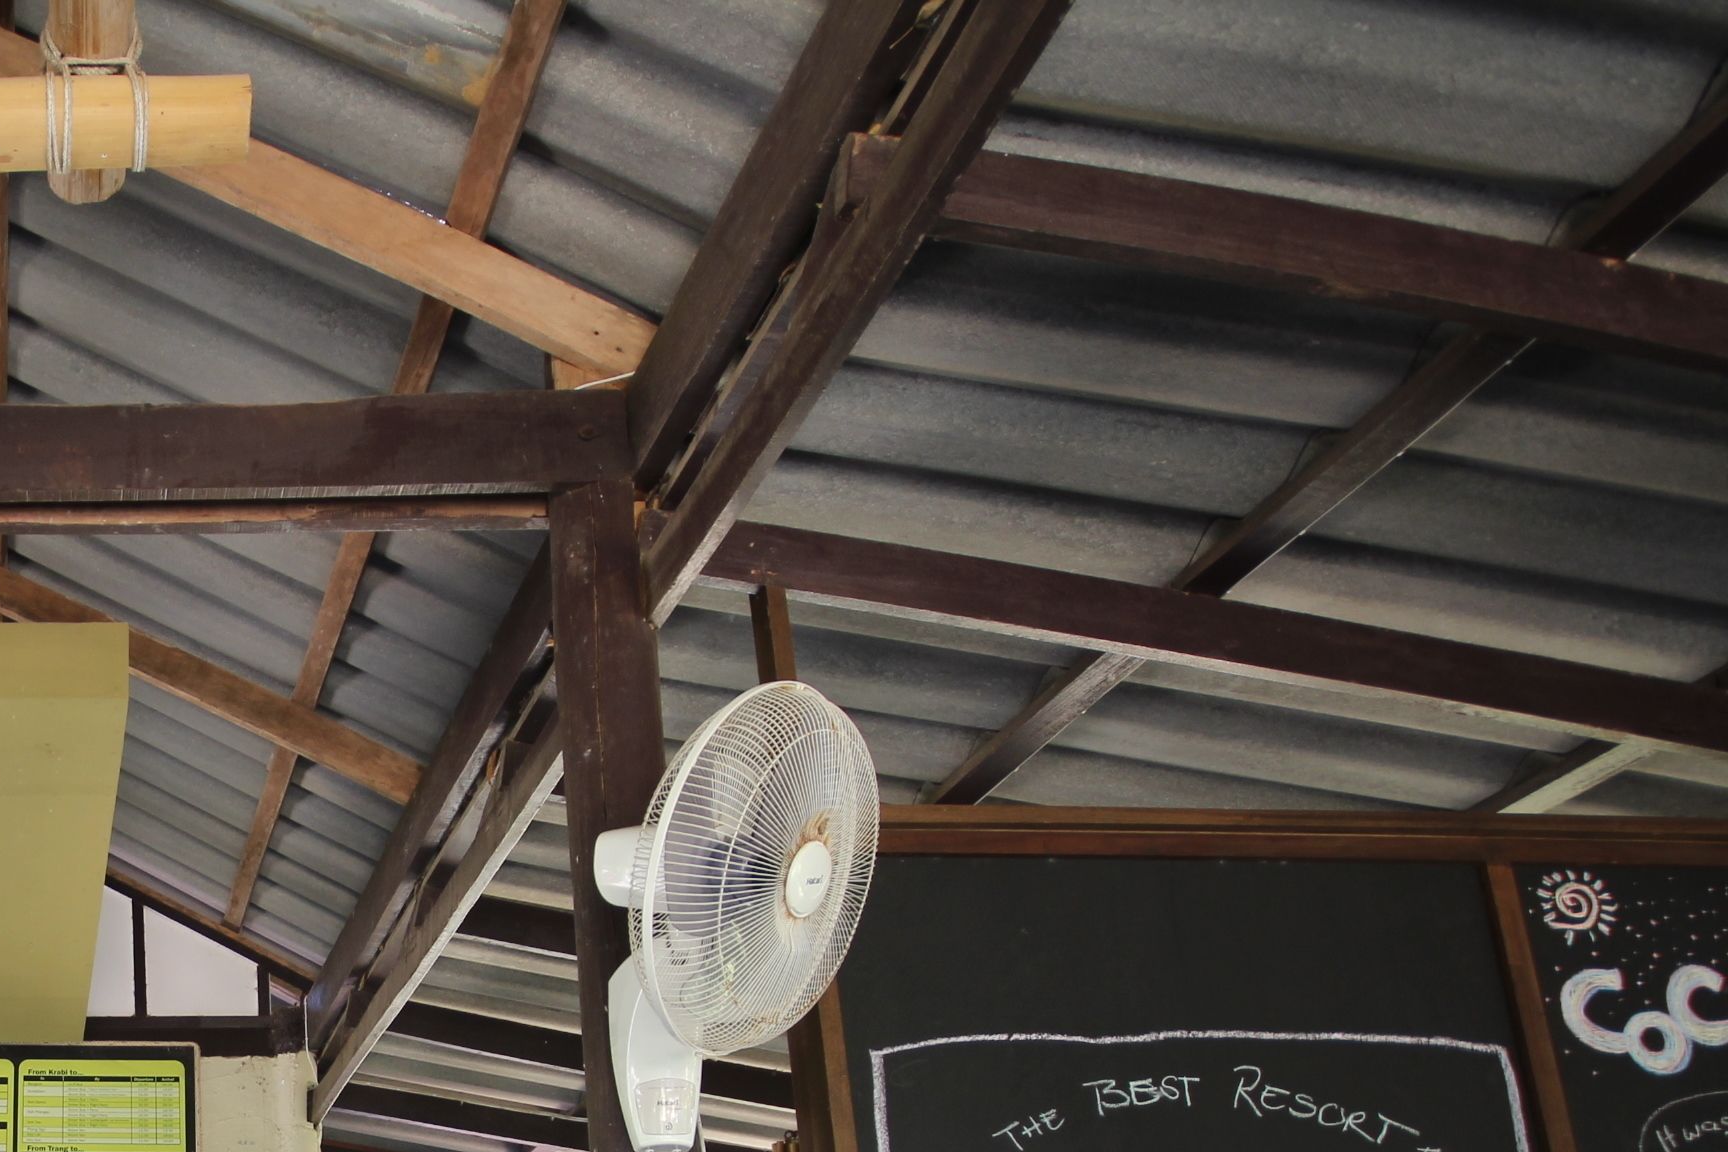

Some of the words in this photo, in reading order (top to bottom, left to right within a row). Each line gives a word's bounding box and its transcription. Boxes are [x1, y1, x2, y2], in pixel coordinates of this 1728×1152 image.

[992, 1108, 1066, 1152] THE
[1082, 1075, 1200, 1117] BEST
[1233, 1064, 1420, 1145] RESORT
